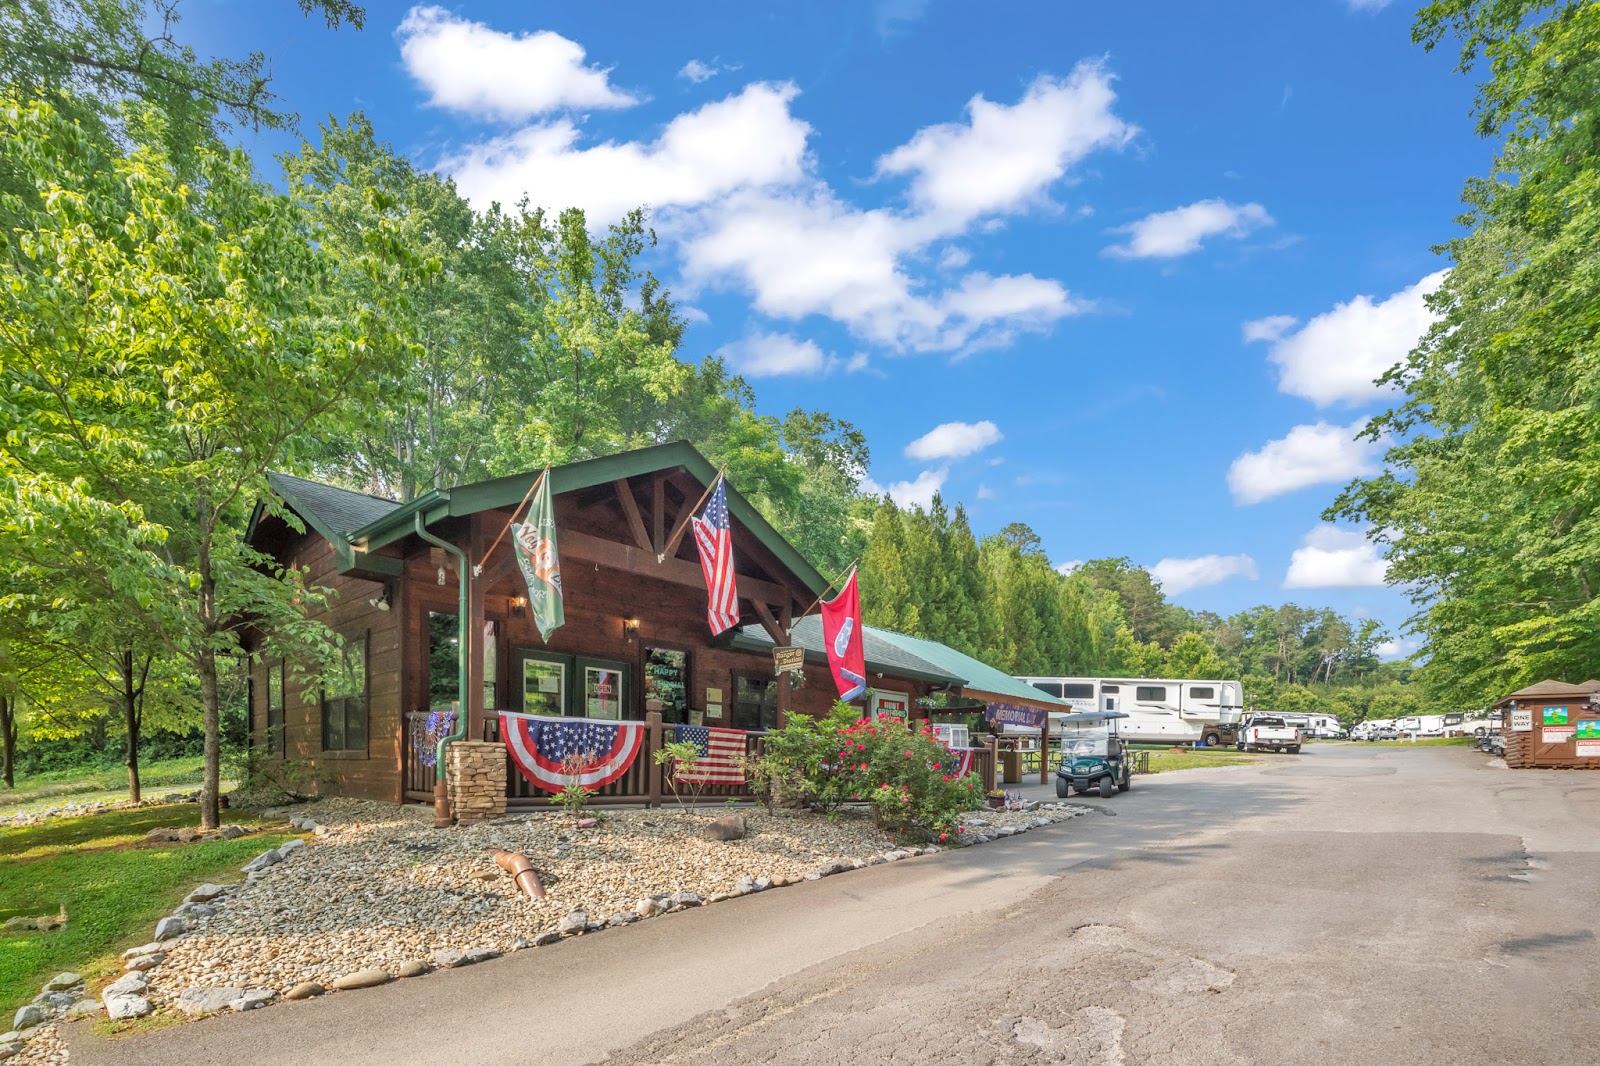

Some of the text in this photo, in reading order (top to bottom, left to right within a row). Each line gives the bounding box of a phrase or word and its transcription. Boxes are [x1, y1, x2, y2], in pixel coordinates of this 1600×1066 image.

[653, 667, 678, 677] HAPPY
[594, 685, 611, 693] OPEN
[995, 709, 1026, 723] MEMORIAL
